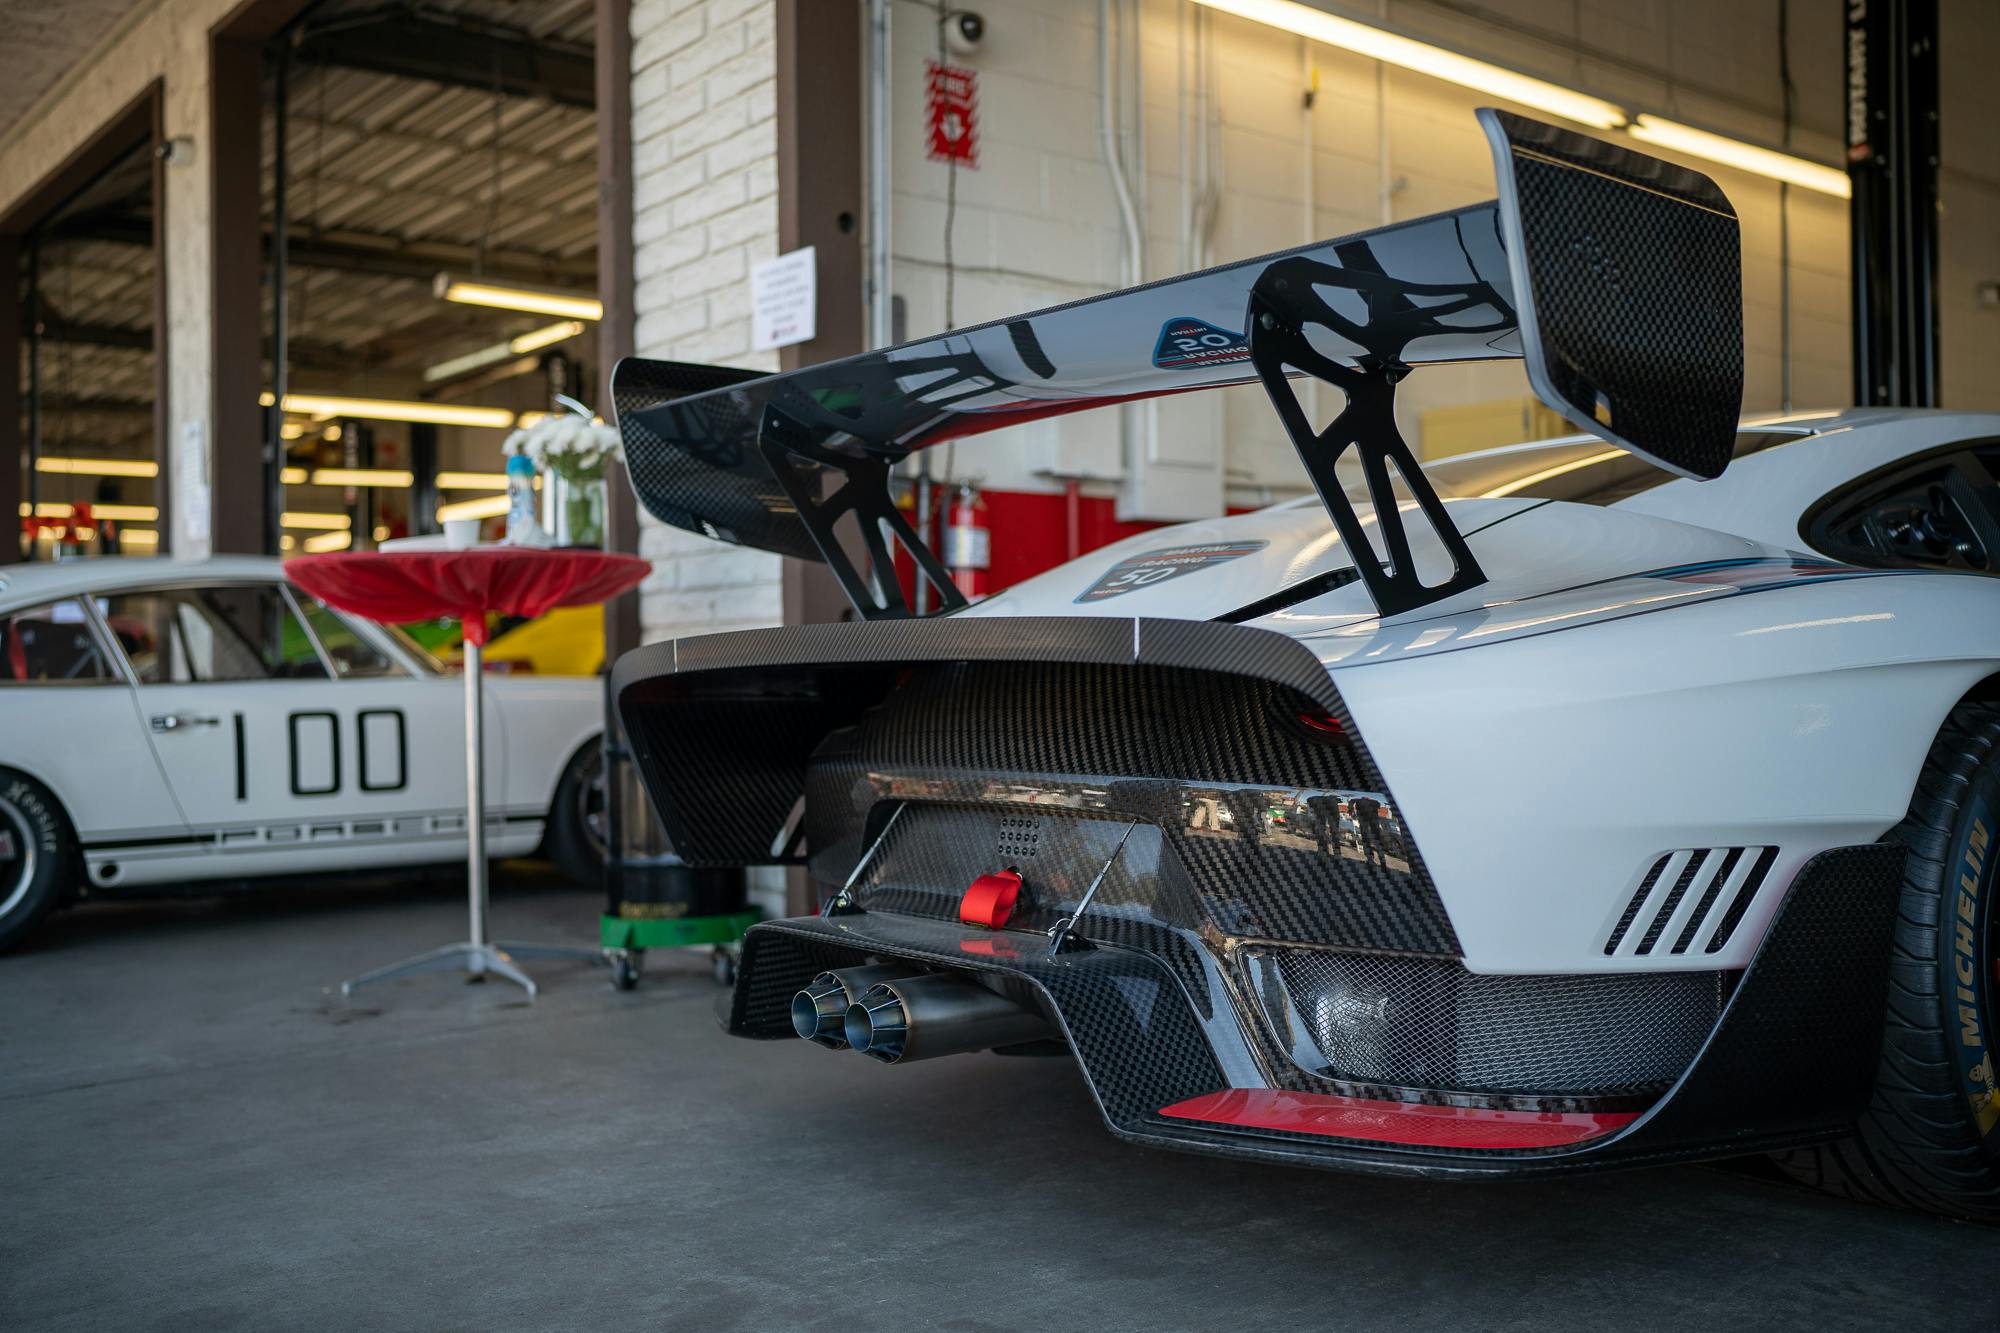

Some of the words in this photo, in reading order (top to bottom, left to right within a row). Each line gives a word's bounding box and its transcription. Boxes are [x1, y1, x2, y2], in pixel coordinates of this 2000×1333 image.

[1106, 567, 1178, 587] 50
[233, 707, 409, 802] 100
[1955, 817, 1989, 1047] MICHELIN
